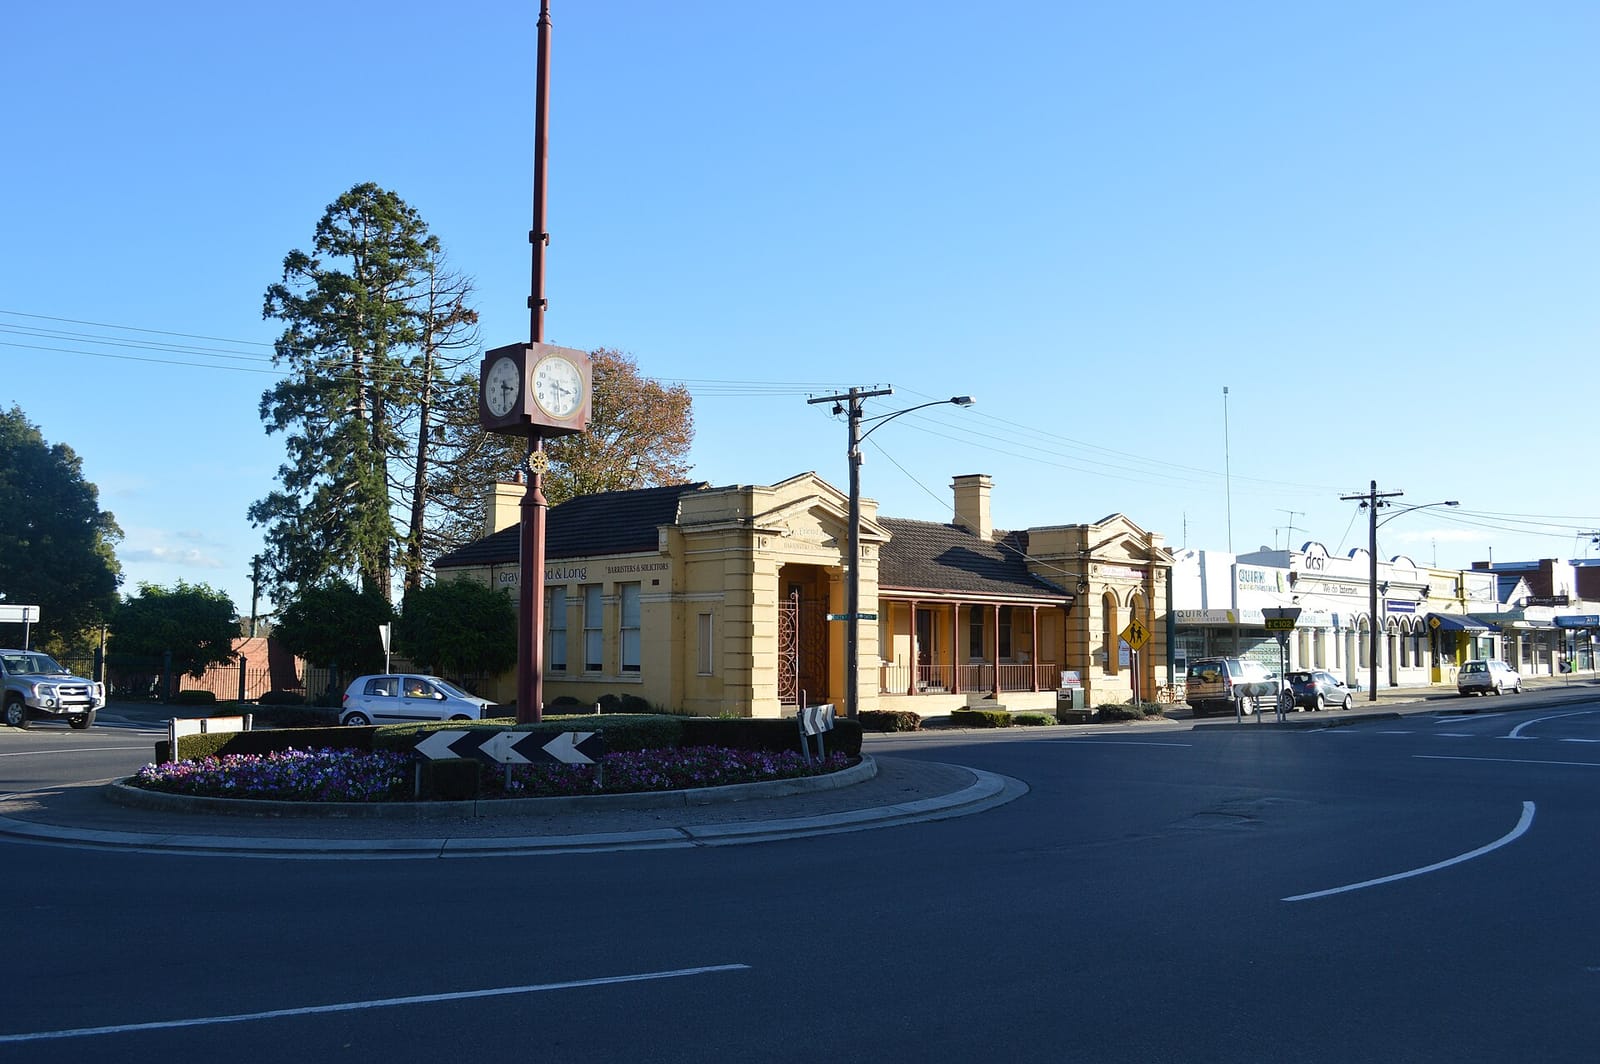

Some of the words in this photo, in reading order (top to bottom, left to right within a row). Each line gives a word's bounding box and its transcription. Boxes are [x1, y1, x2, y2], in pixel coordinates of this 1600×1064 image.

[1305, 551, 1325, 571] dcsi
[555, 568, 562, 579] &
[563, 566, 588, 581] Long
[607, 564, 636, 574] BARRISTERS
[641, 562, 669, 572] SOLICITORS
[1238, 568, 1265, 584] QUIRK
[1176, 609, 1209, 618] QUIRK
[1273, 619, 1293, 628] C102
